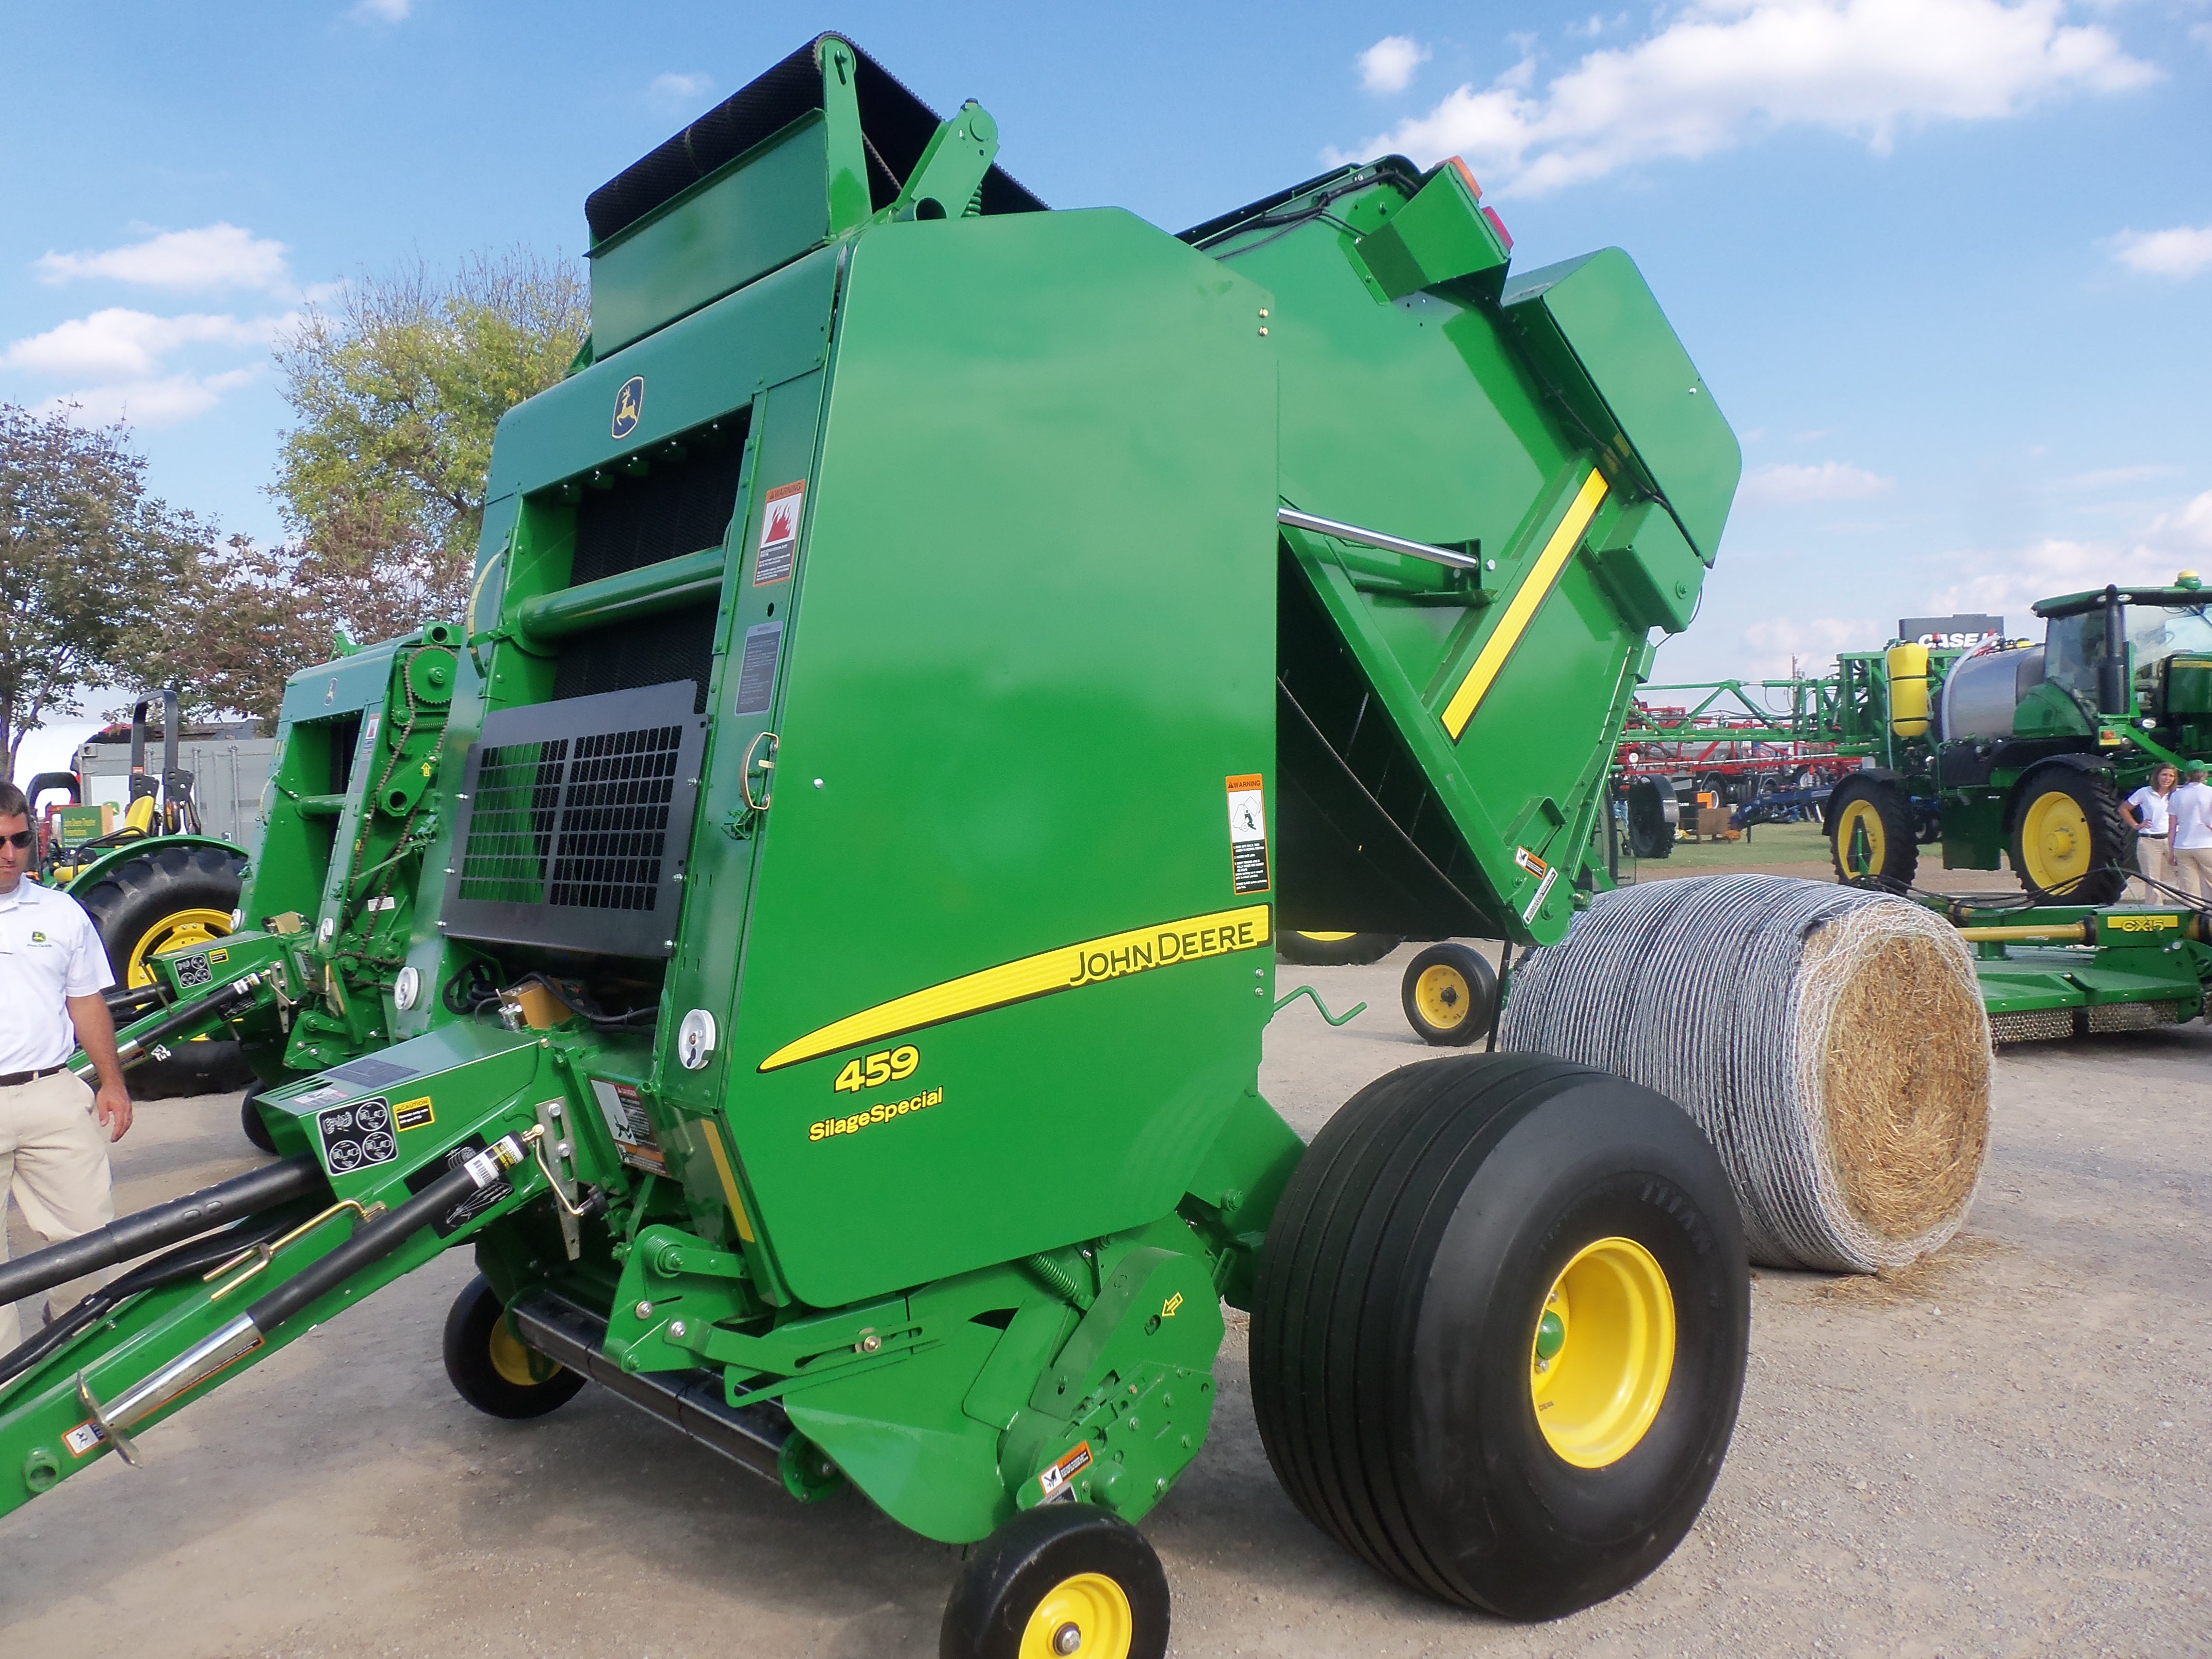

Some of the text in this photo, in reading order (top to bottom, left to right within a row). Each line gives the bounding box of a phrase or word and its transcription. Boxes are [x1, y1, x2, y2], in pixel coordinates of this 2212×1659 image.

[1233, 780, 1261, 788] WARNING
[2122, 919, 2165, 932] CX15
[1070, 921, 1255, 982] JOHN DEERE
[834, 1044, 921, 1094] 459
[401, 1100, 428, 1110] CAUTION
[808, 1085, 944, 1142] SilageSpecial
